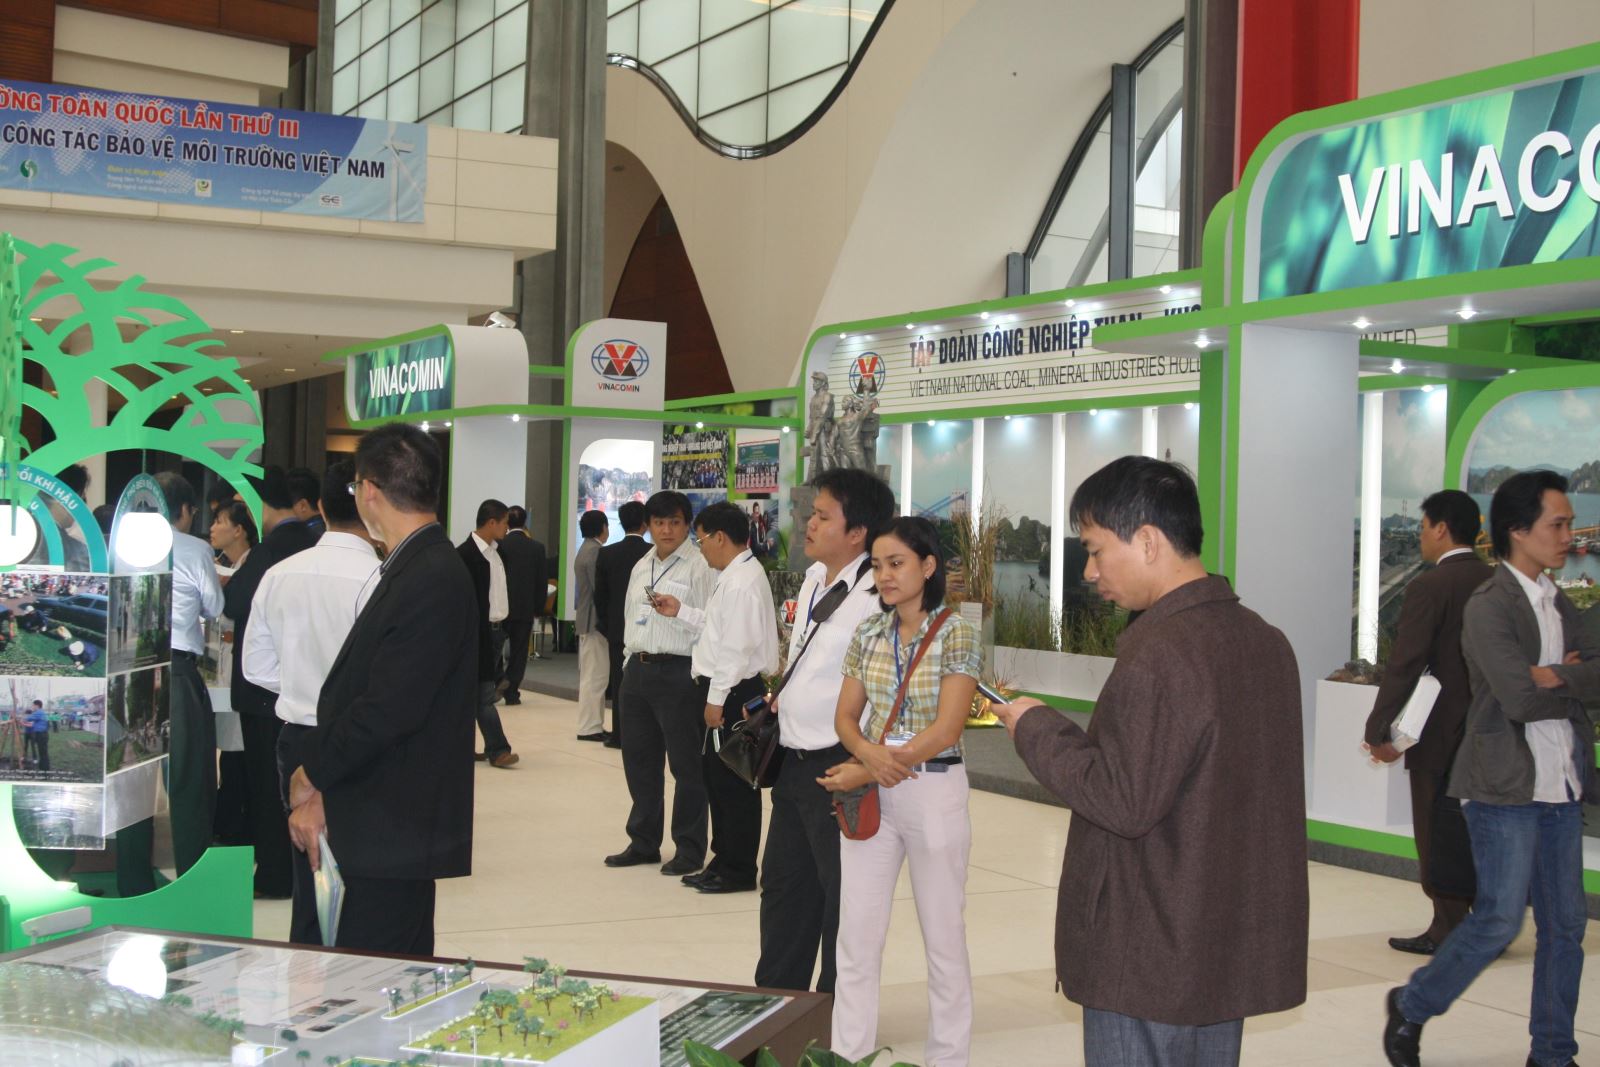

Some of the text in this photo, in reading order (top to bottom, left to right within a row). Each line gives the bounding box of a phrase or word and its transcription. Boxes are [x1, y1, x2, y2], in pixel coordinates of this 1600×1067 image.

[48, 94, 108, 119] TOÀN
[114, 99, 174, 126] QUỐC
[229, 112, 273, 136] THỨ
[278, 119, 299, 139] III
[3, 121, 385, 179] CÔNG TÁC BẢO VỆ MÔI TRƯỜNG VIỆT NAM
[939, 329, 978, 364] ĐOÀN
[982, 324, 1024, 360] CÔNG
[1029, 314, 1090, 358] NGHIỆP
[369, 356, 445, 399] VINACOMIN
[597, 382, 640, 392] VINACOMIN
[909, 376, 951, 398] VIETNAM
[953, 372, 1001, 393] NATIONAL
[1039, 362, 1089, 387] MINERAL
[1092, 355, 1166, 382] INDUSTRIES
